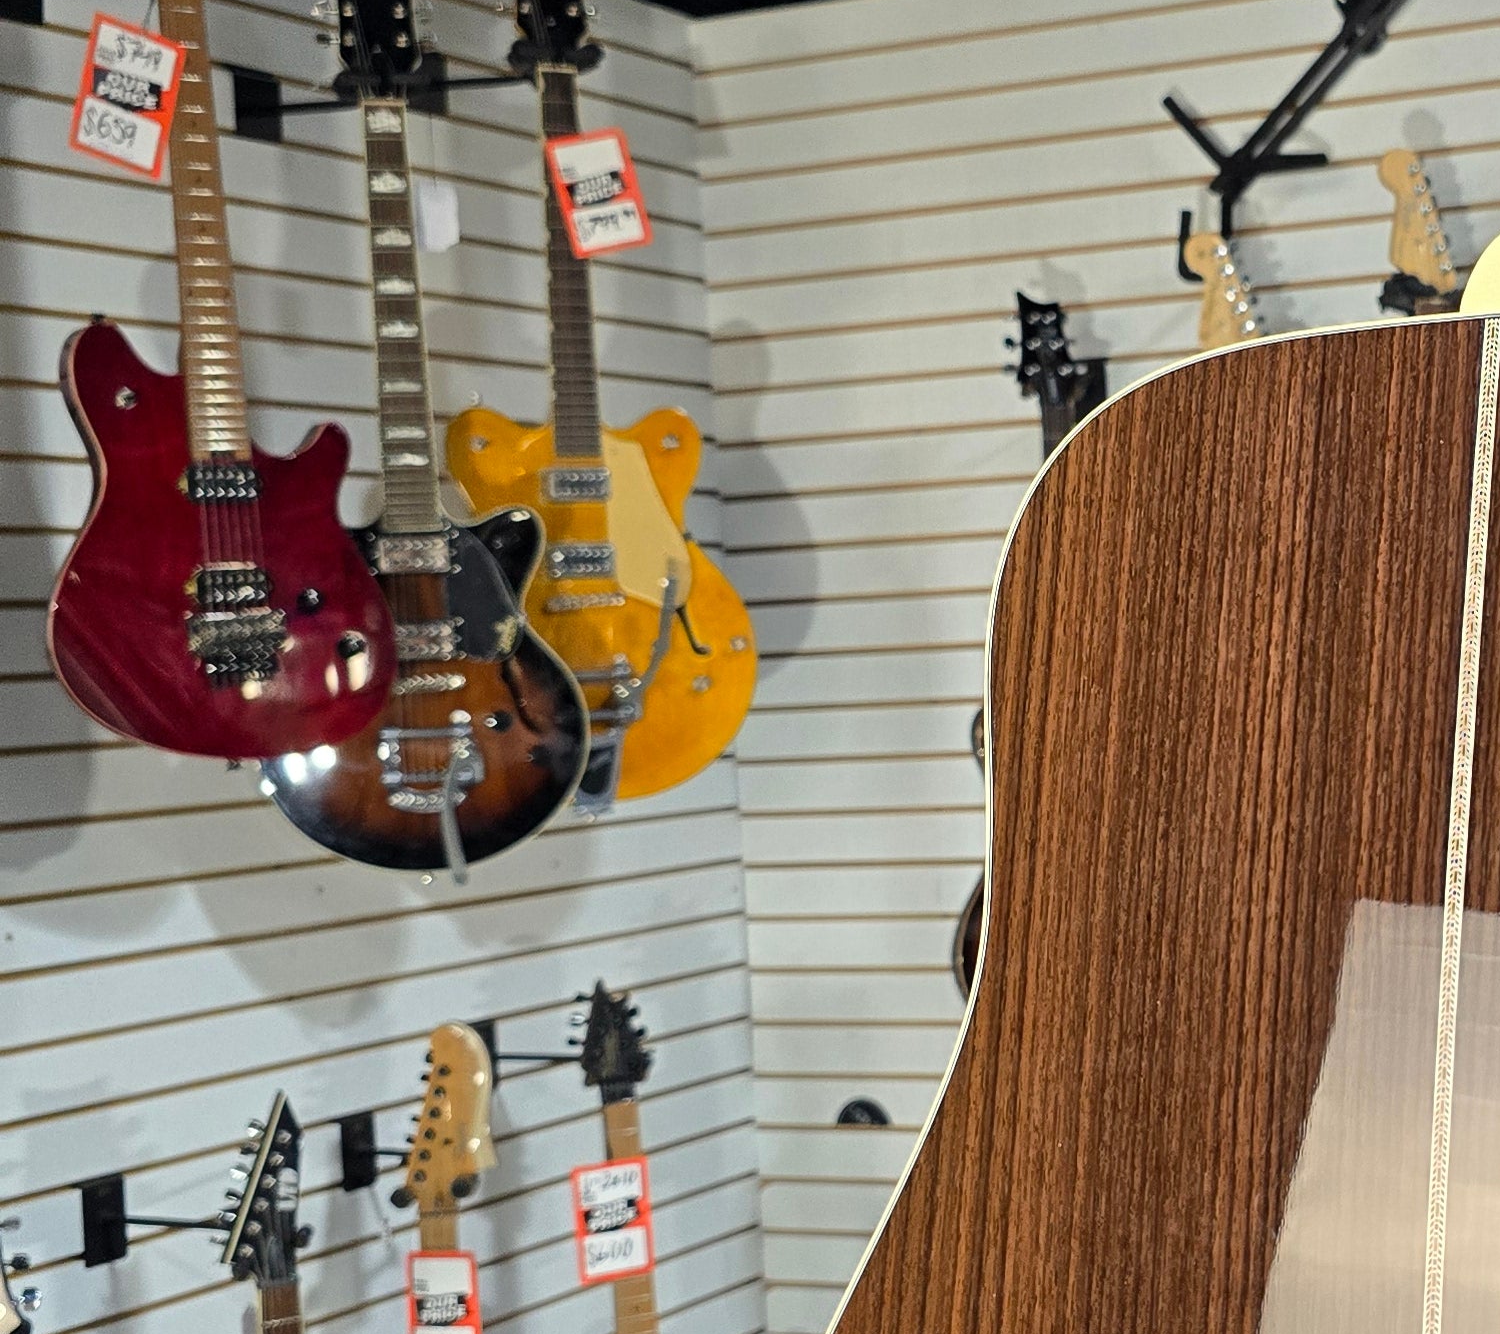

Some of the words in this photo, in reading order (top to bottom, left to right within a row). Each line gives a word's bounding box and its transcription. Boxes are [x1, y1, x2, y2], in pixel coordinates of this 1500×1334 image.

[96, 79, 159, 111] PRICE
[105, 70, 150, 97] OUR
[574, 181, 624, 206] PRICE
[577, 174, 612, 193] OUR
[423, 1293, 459, 1309] OUR
[419, 1303, 468, 1324] PRICE
